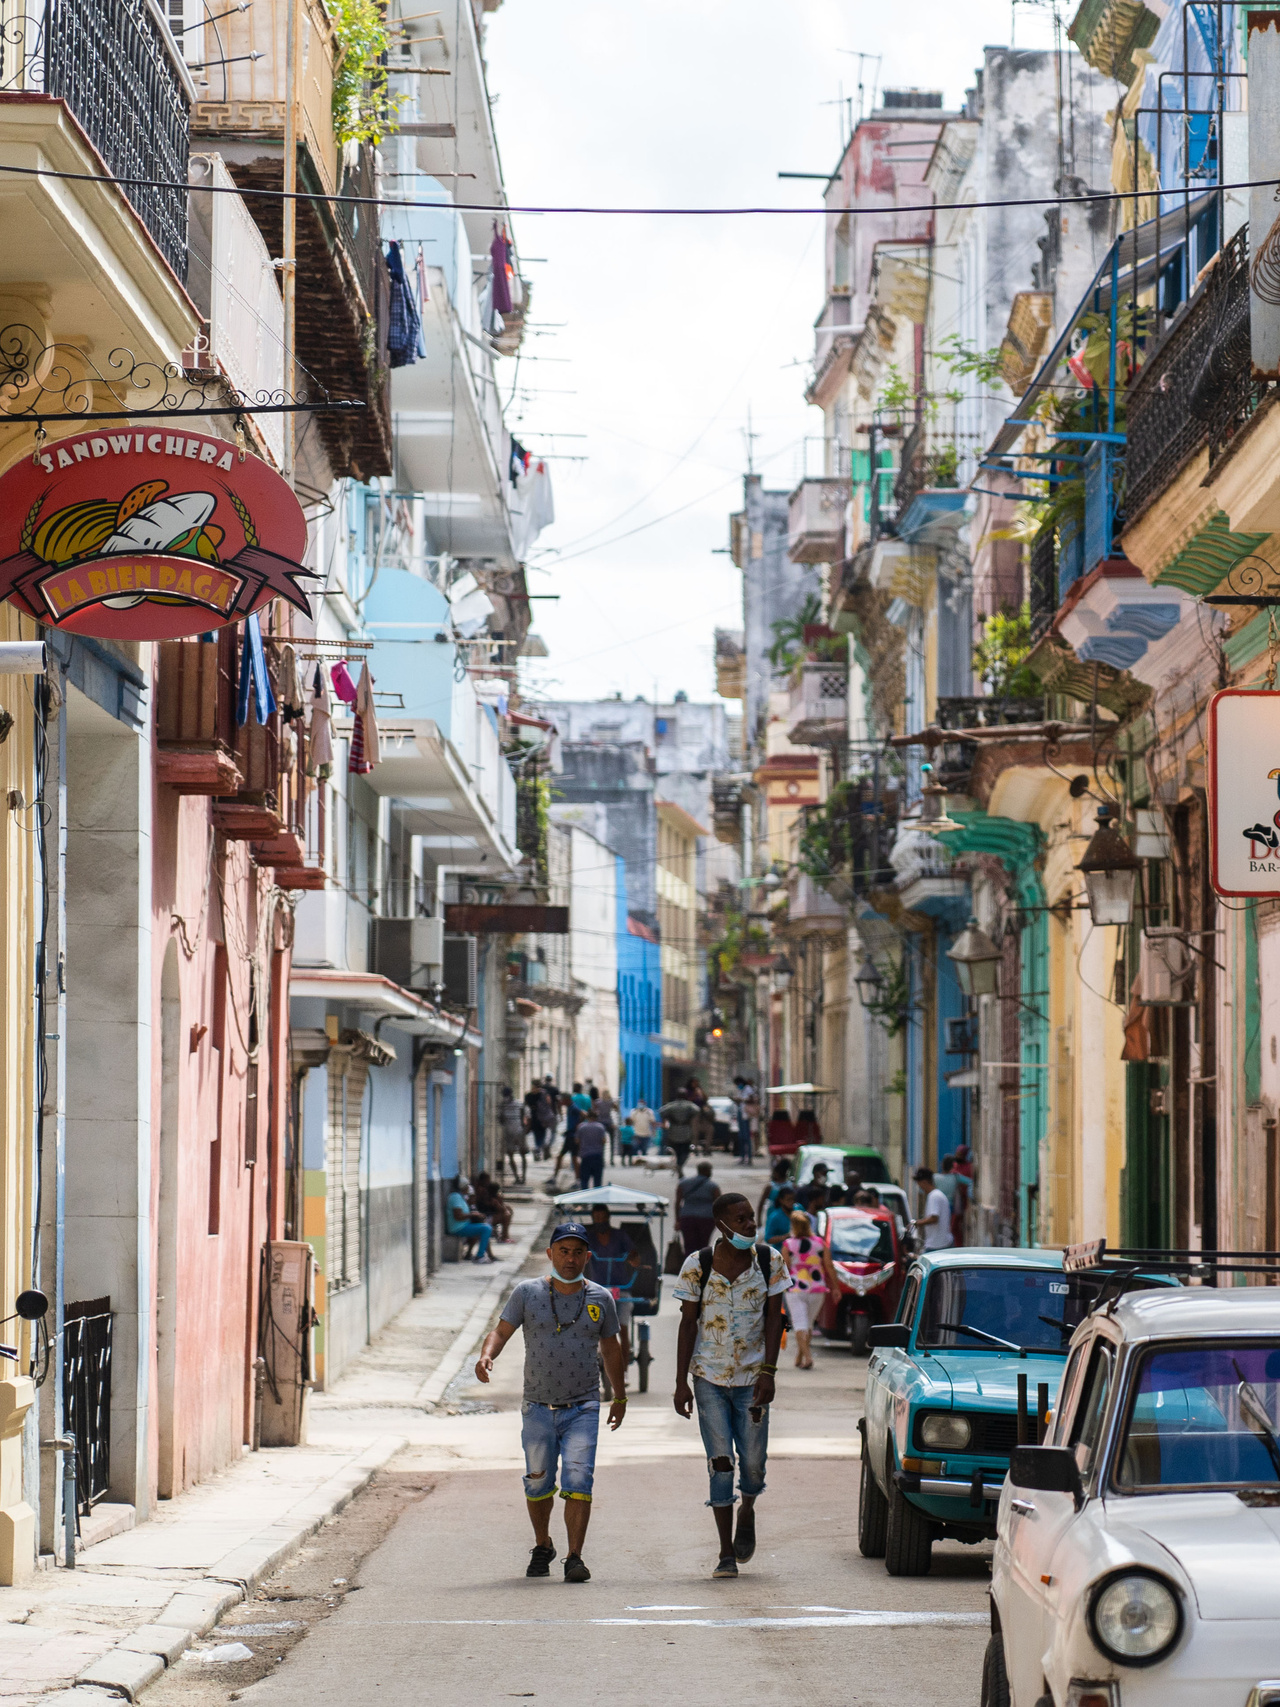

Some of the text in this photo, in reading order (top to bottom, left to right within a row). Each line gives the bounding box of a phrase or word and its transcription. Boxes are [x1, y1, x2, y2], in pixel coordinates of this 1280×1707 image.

[40, 433, 234, 473] SANDWICHERA
[50, 578, 84, 610] LA
[88, 564, 152, 596] BIEN
[1050, 1283, 1061, 1293] 17
